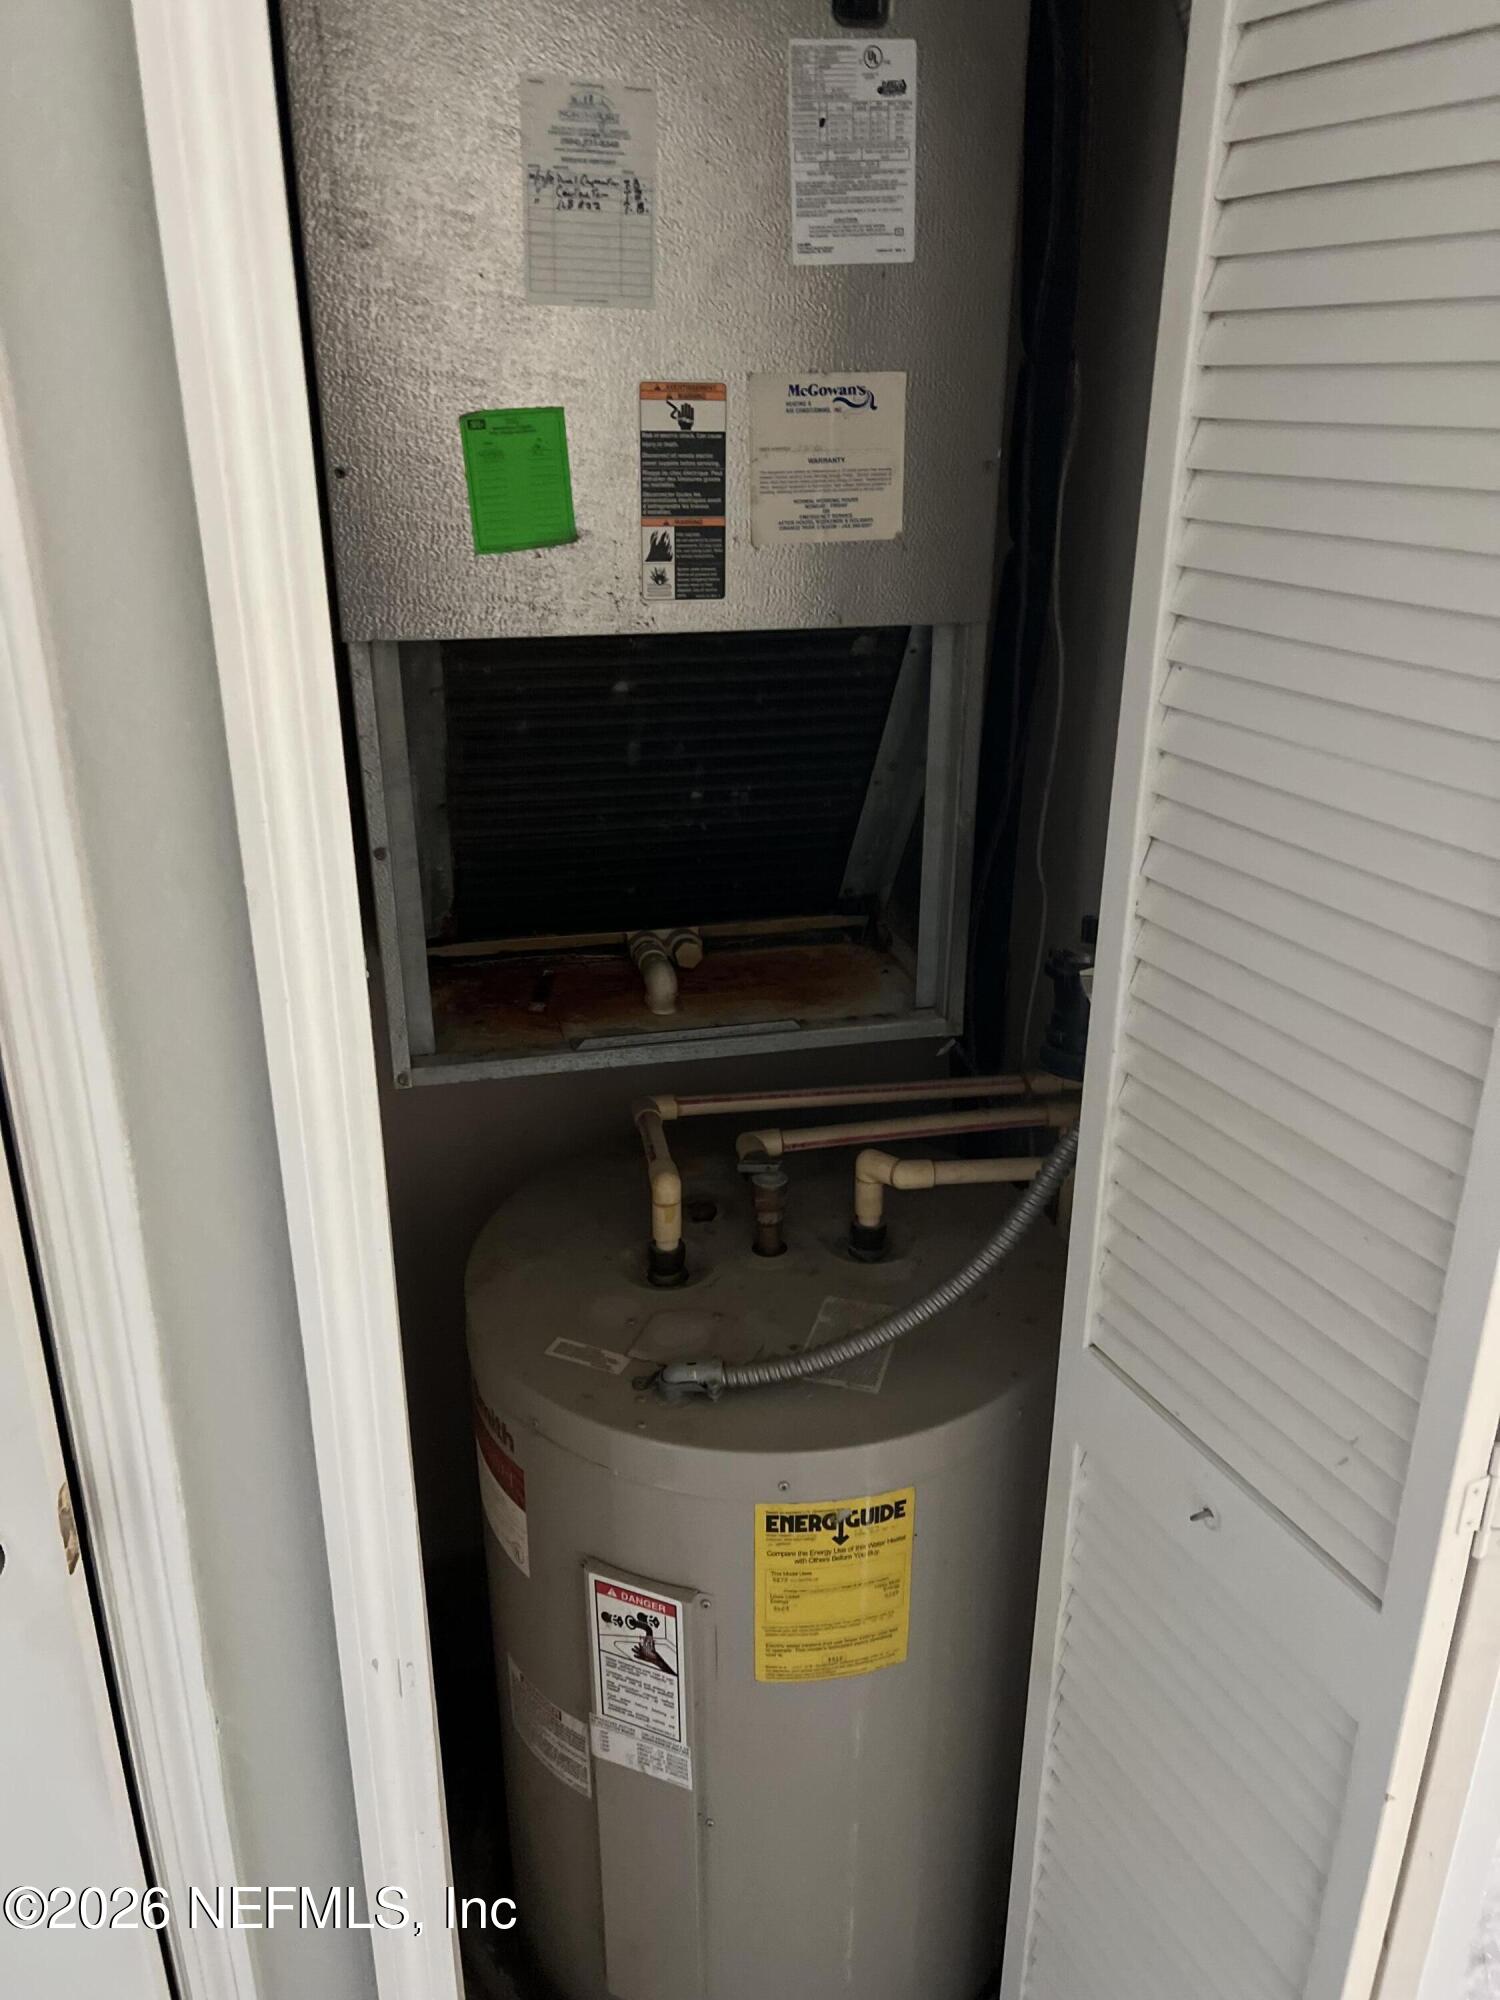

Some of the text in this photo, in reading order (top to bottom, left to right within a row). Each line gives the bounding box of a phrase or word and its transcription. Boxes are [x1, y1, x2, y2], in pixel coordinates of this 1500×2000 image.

[788, 383, 867, 398] McGowan's
[810, 1548, 831, 1557] Energy
[621, 1591, 666, 1613] DANGER
